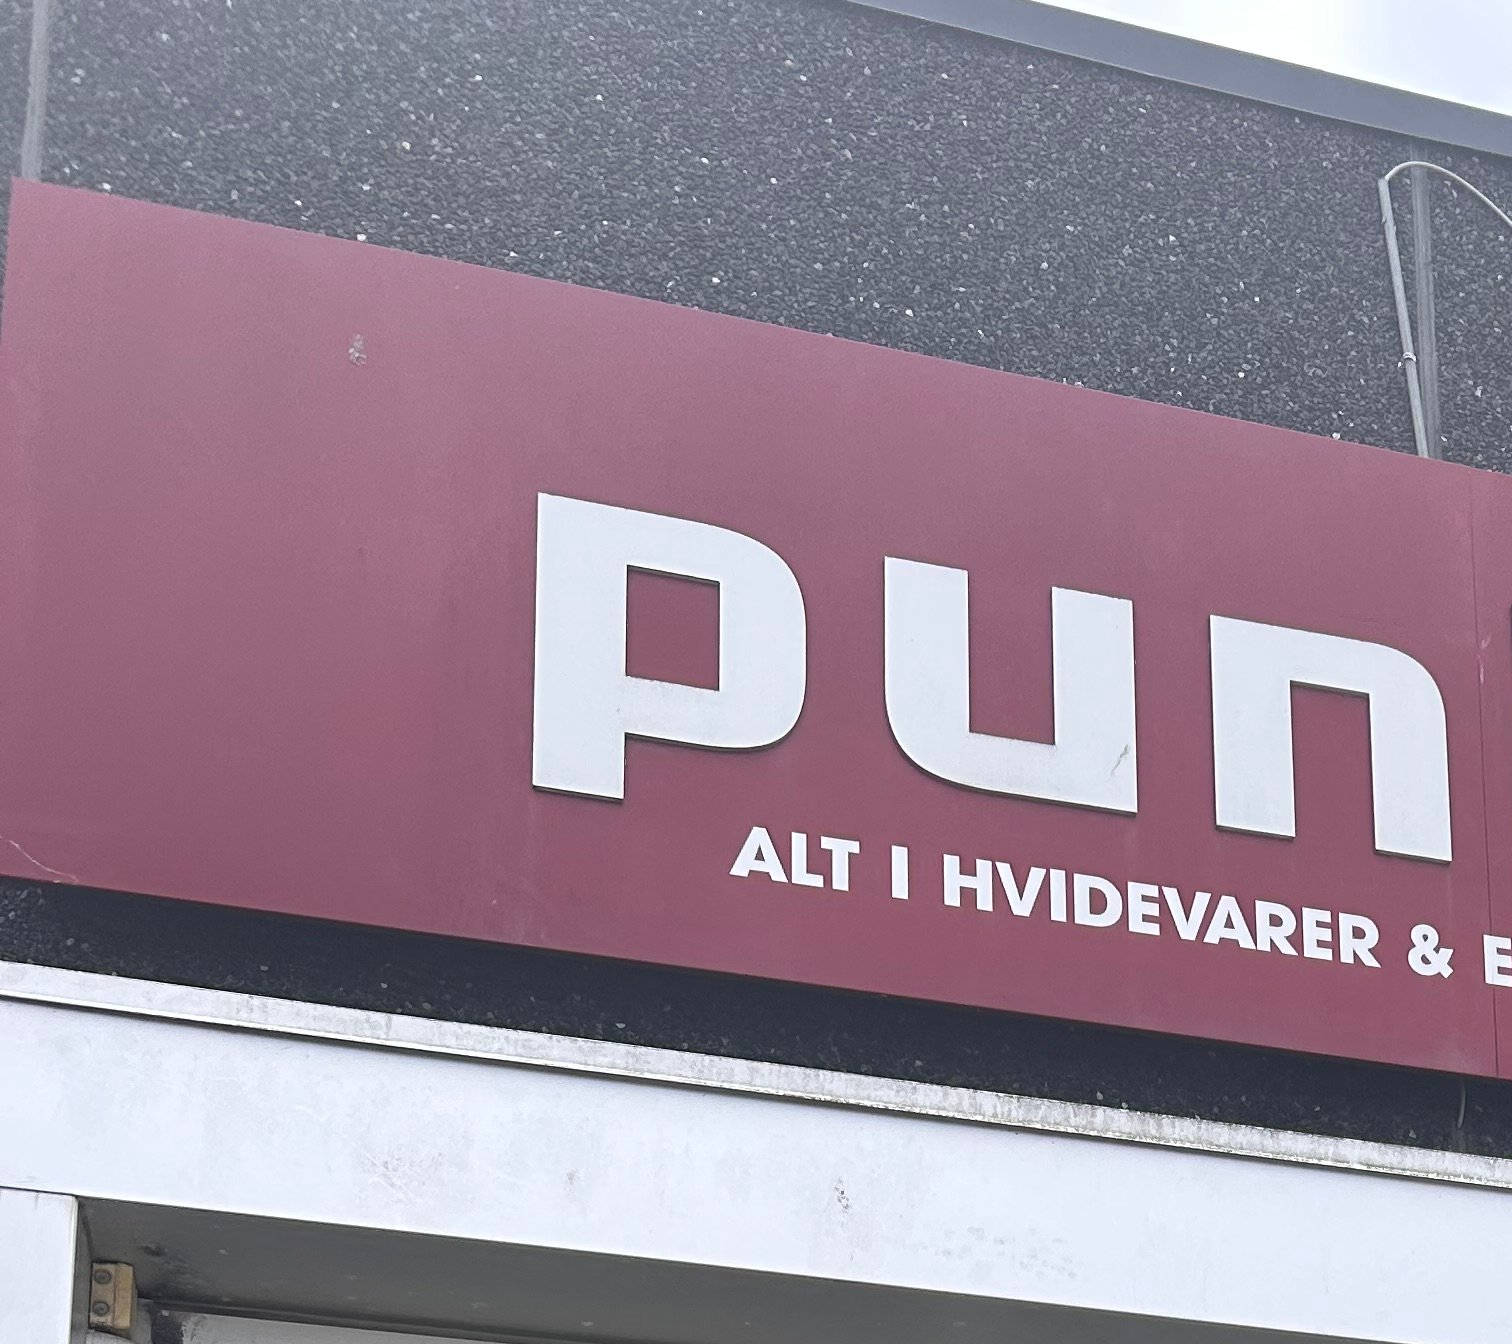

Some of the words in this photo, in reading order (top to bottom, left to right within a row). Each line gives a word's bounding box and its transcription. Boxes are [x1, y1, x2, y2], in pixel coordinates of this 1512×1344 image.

[728, 826, 860, 891] ALT
[891, 844, 909, 900] I
[942, 853, 1382, 969] HVIDEVARER
[1407, 923, 1454, 979] &
